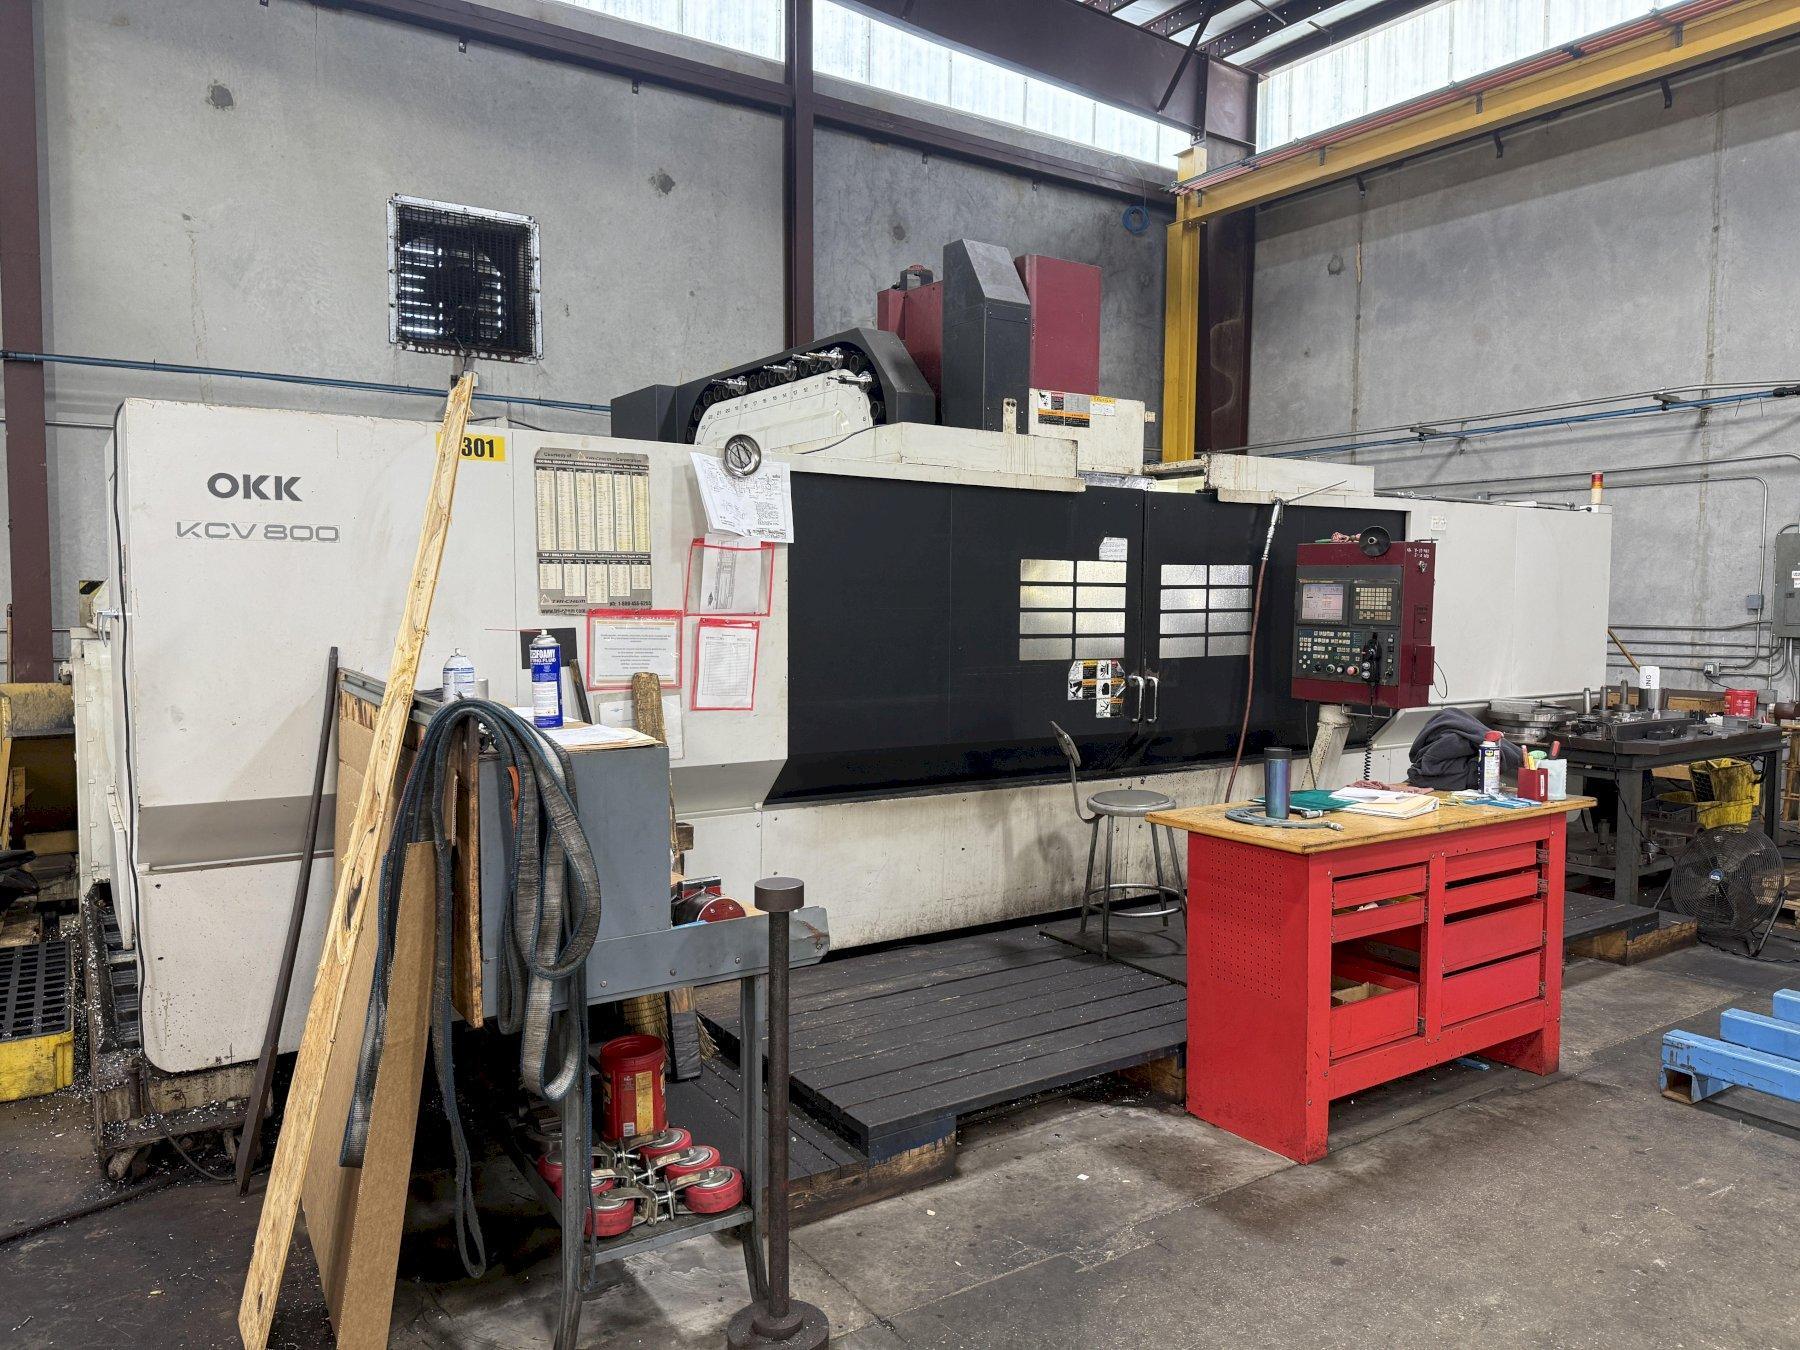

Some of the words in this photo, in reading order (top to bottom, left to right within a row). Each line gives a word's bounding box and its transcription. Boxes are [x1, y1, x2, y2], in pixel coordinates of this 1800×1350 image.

[207, 472, 303, 502] OKK
[176, 521, 258, 539] KCV
[263, 524, 339, 542] 800
